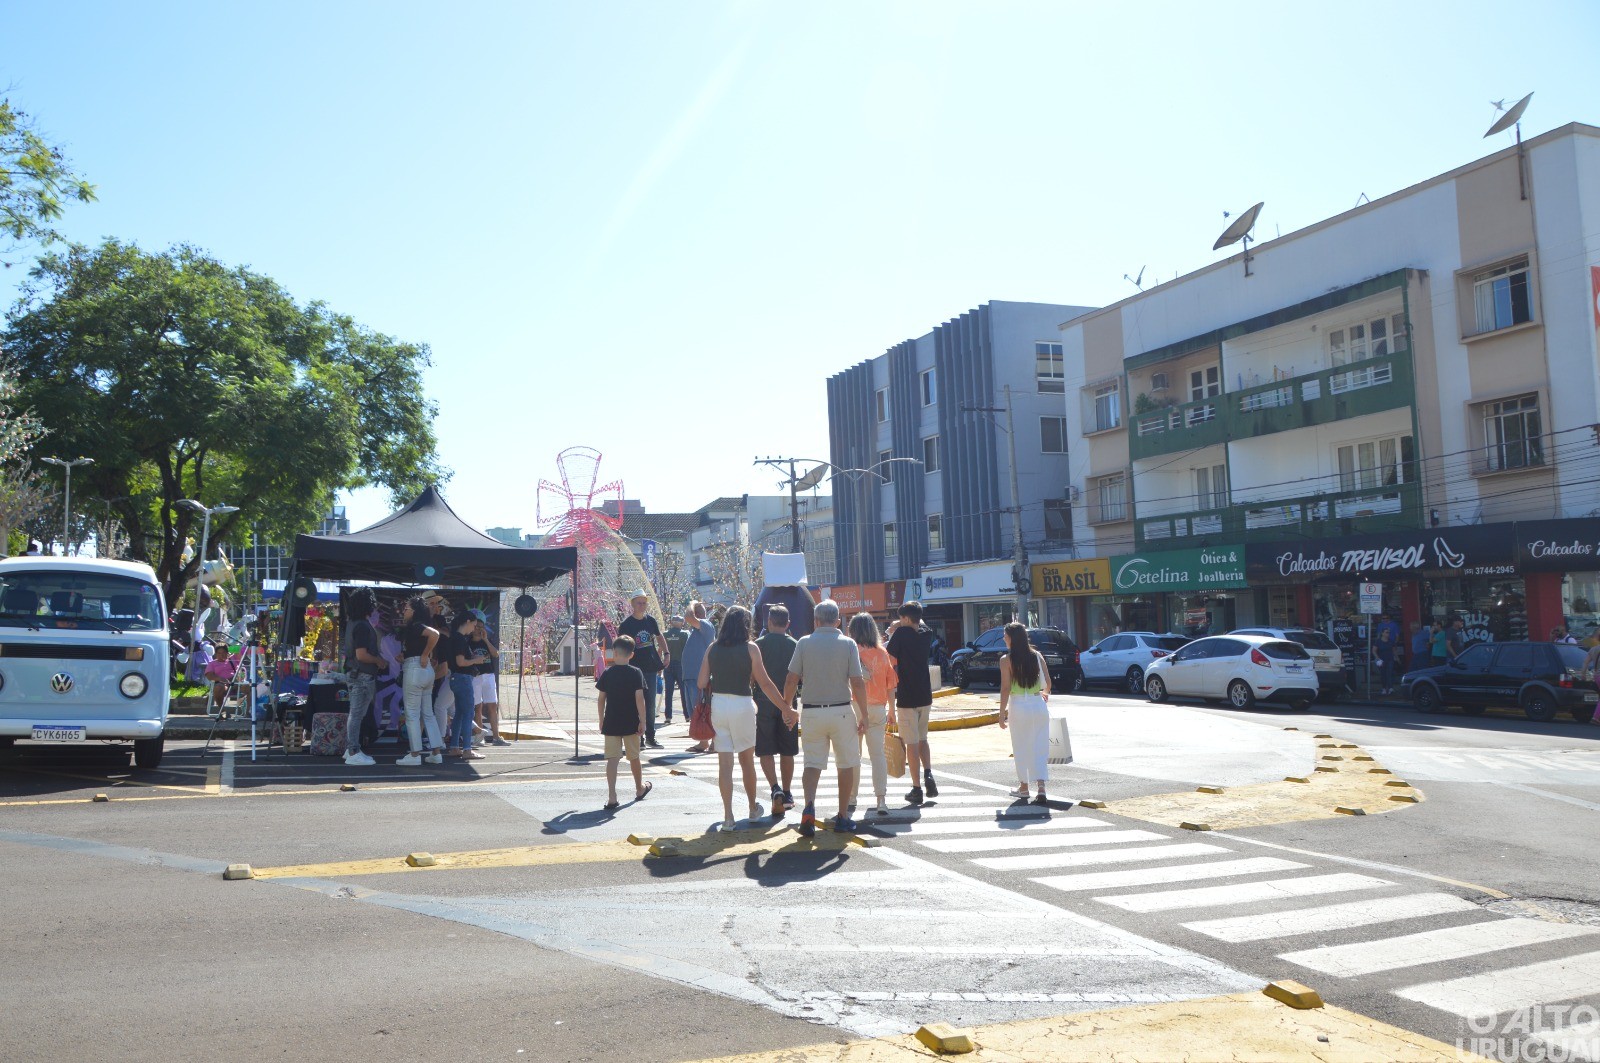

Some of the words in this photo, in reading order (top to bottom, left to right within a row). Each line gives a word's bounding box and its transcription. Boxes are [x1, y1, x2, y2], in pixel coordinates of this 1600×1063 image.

[1201, 549, 1227, 564] Ótica
[1229, 551, 1238, 562] &
[1528, 540, 1592, 558] Calçados
[1276, 551, 1338, 576] Calçados
[1340, 543, 1426, 572] TREVISOL
[1042, 567, 1059, 576] Casa
[1116, 558, 1189, 589] Getelina
[1198, 568, 1244, 583] Joalheria
[1475, 565, 1515, 575] 3744-2945
[1043, 567, 1100, 592] BRASIL
[36, 730, 80, 740] CYK6H65
